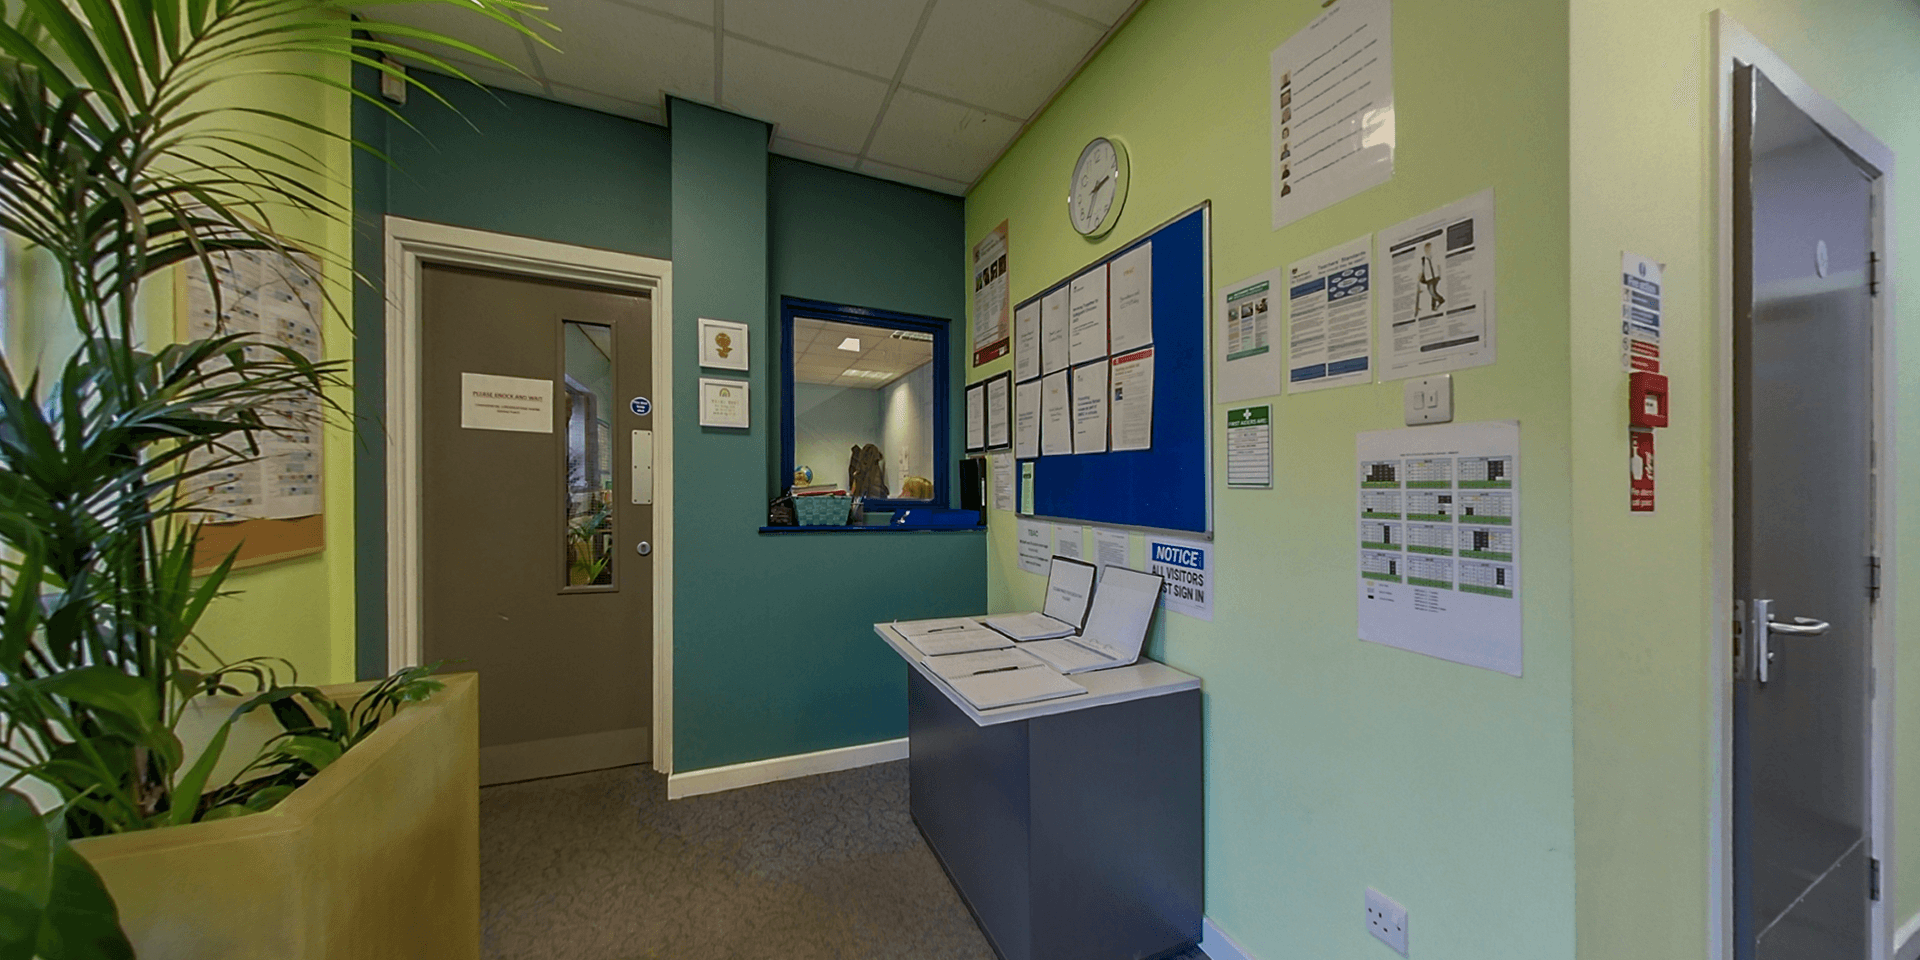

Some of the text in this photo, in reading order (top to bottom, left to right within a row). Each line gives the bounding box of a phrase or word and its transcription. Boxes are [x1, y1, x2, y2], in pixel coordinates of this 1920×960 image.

[1156, 545, 1199, 568] NOTICE
[1152, 564, 1204, 587] ALL VISITORS
[1161, 581, 1204, 603] ST SIGN IN
